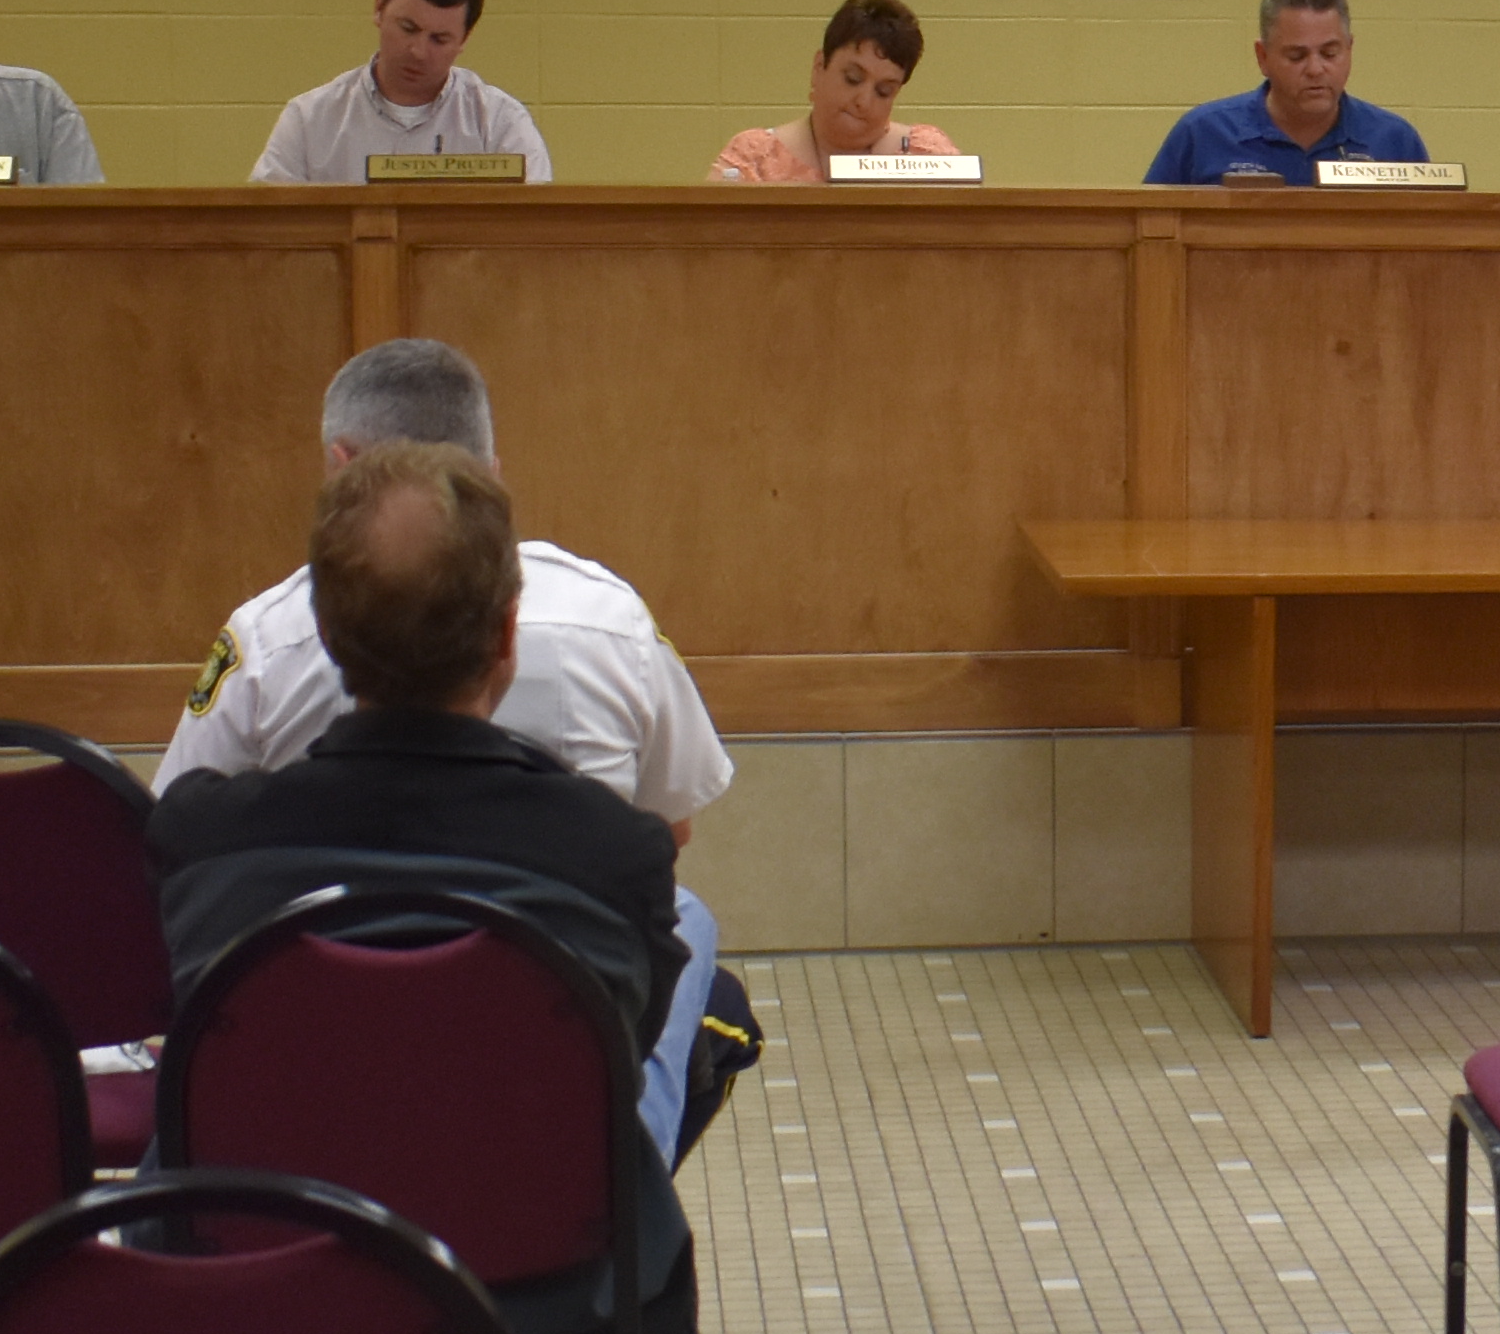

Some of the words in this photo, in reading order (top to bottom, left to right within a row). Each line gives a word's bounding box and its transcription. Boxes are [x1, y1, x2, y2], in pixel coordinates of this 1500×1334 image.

[381, 158, 437, 171] JUSTIN
[444, 158, 510, 171] PRUETT
[858, 158, 888, 170] KIM
[895, 158, 952, 170] BROWN
[1332, 164, 1408, 178] KENNETH
[1413, 165, 1453, 179] NAIL
